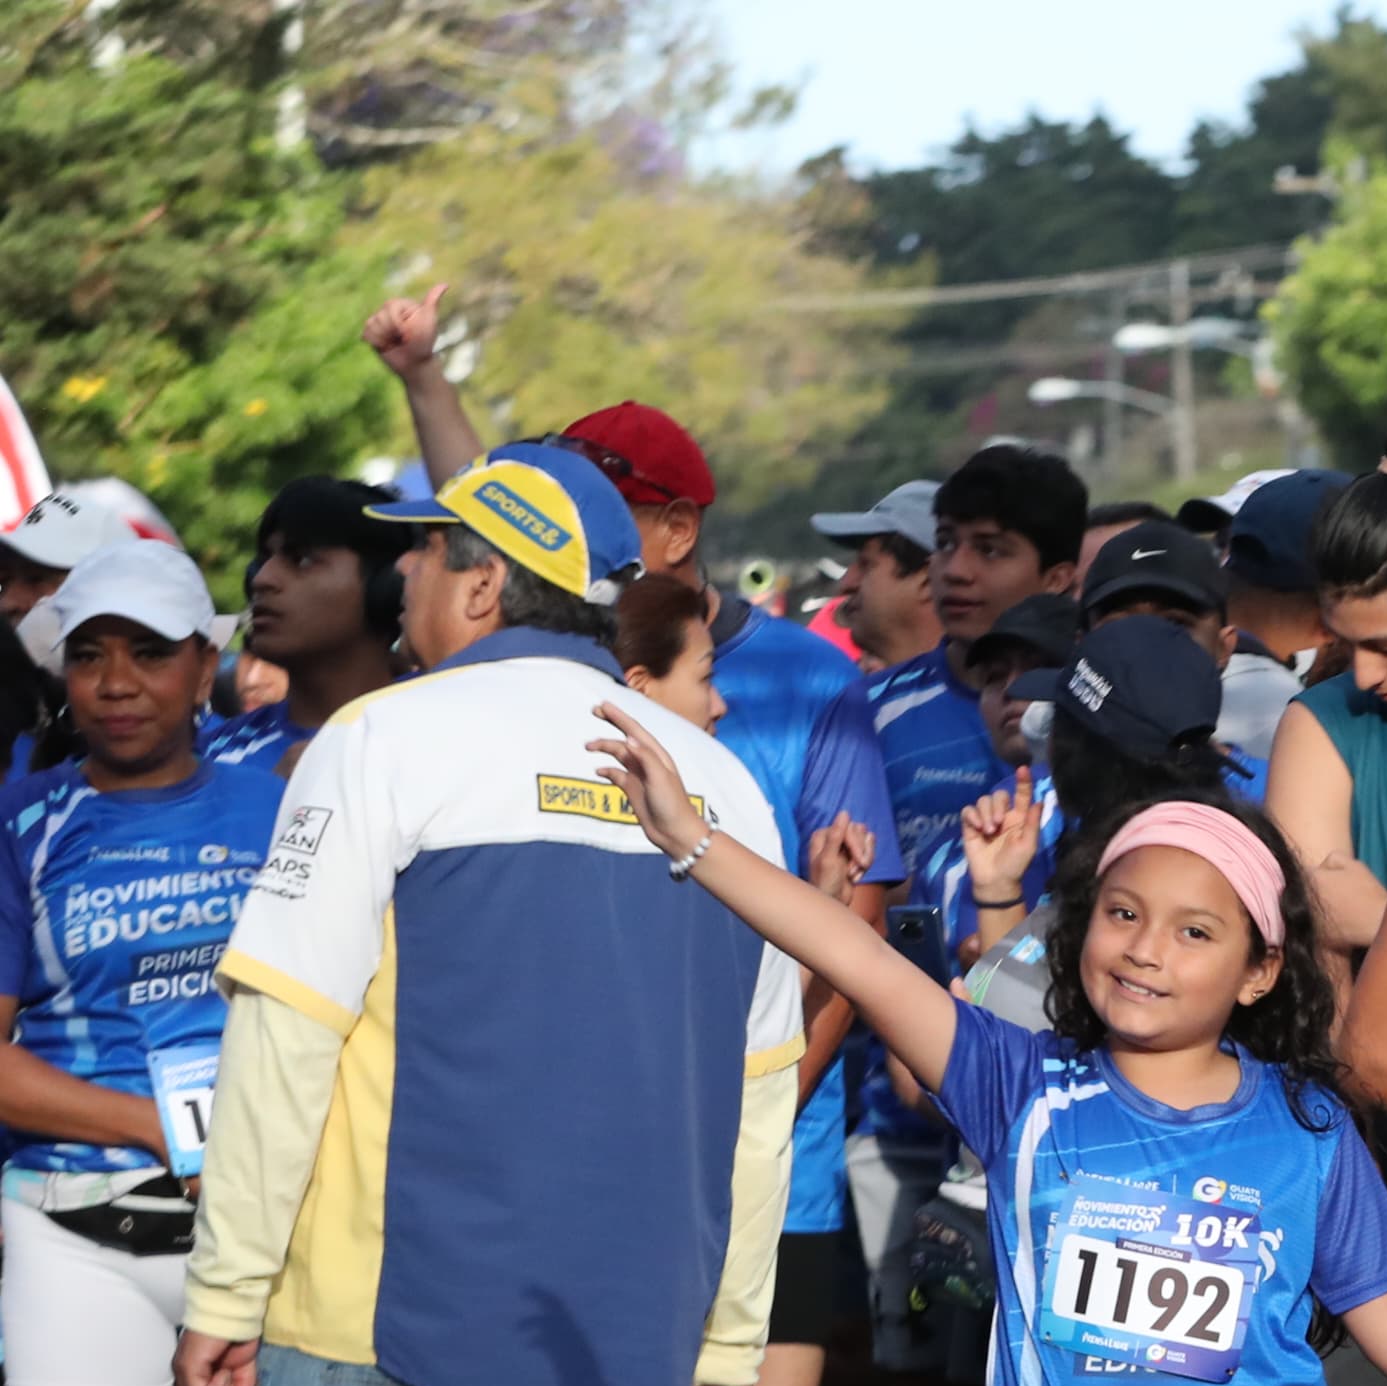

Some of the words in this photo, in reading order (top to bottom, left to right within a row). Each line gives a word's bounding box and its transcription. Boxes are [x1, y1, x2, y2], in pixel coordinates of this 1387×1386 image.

[543, 783, 597, 811] SPORTS
[602, 794, 611, 813] &
[1068, 1213, 1156, 1233] EDUCACIÓN
[1073, 1200, 1148, 1218] MOVIMIENTO
[1170, 1213, 1252, 1249] 10K
[1074, 1249, 1231, 1343] 1192
